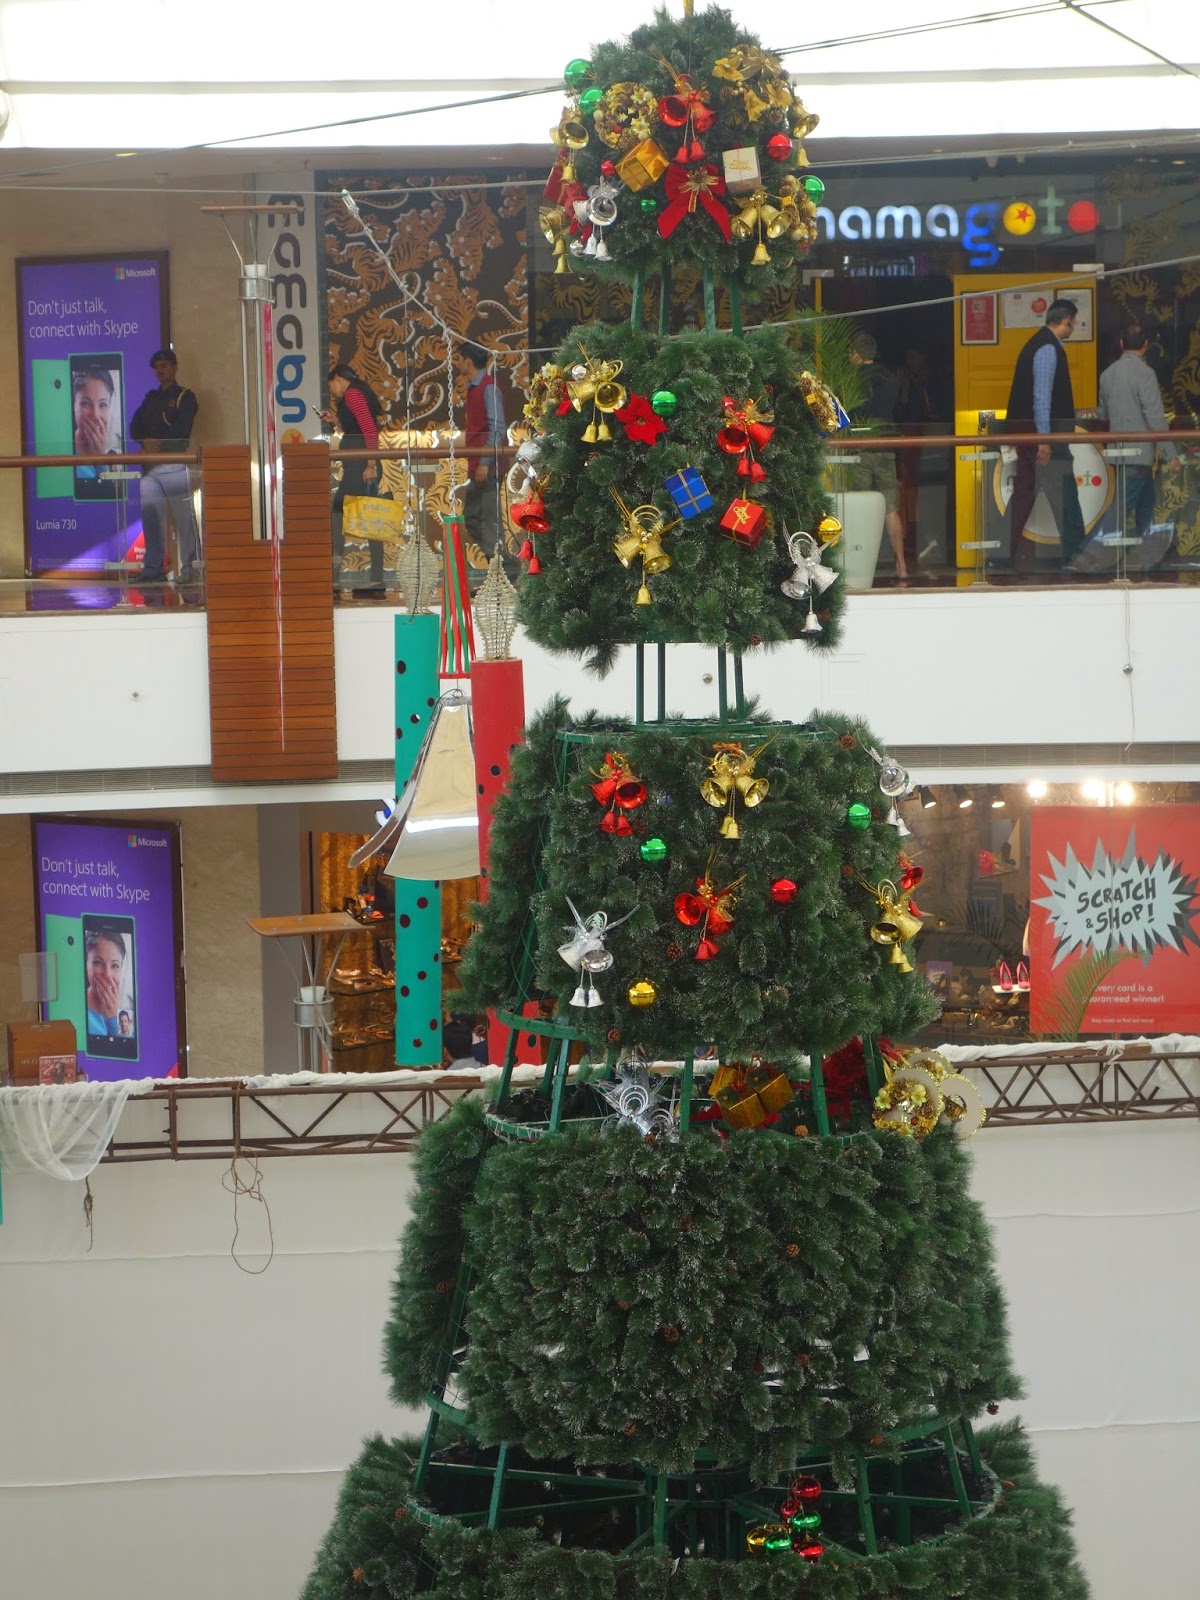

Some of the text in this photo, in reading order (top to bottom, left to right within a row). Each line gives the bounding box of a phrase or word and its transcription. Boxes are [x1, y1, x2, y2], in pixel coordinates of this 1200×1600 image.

[126, 267, 156, 278] Microsoft
[28, 297, 107, 318] Don't just talk,
[29, 319, 139, 339] connect with Skype
[36, 519, 77, 530] Lumia 730
[137, 838, 168, 848] Microsoft
[41, 857, 120, 878] Don't just talk,
[42, 882, 150, 904] connect with Skype
[1076, 877, 1156, 914] SCRATCH
[1085, 902, 1155, 934] & SHOP!
[1094, 984, 1115, 994] very
[1117, 983, 1136, 992] card
[1138, 984, 1145, 992] is
[1132, 994, 1164, 1003] winner!
